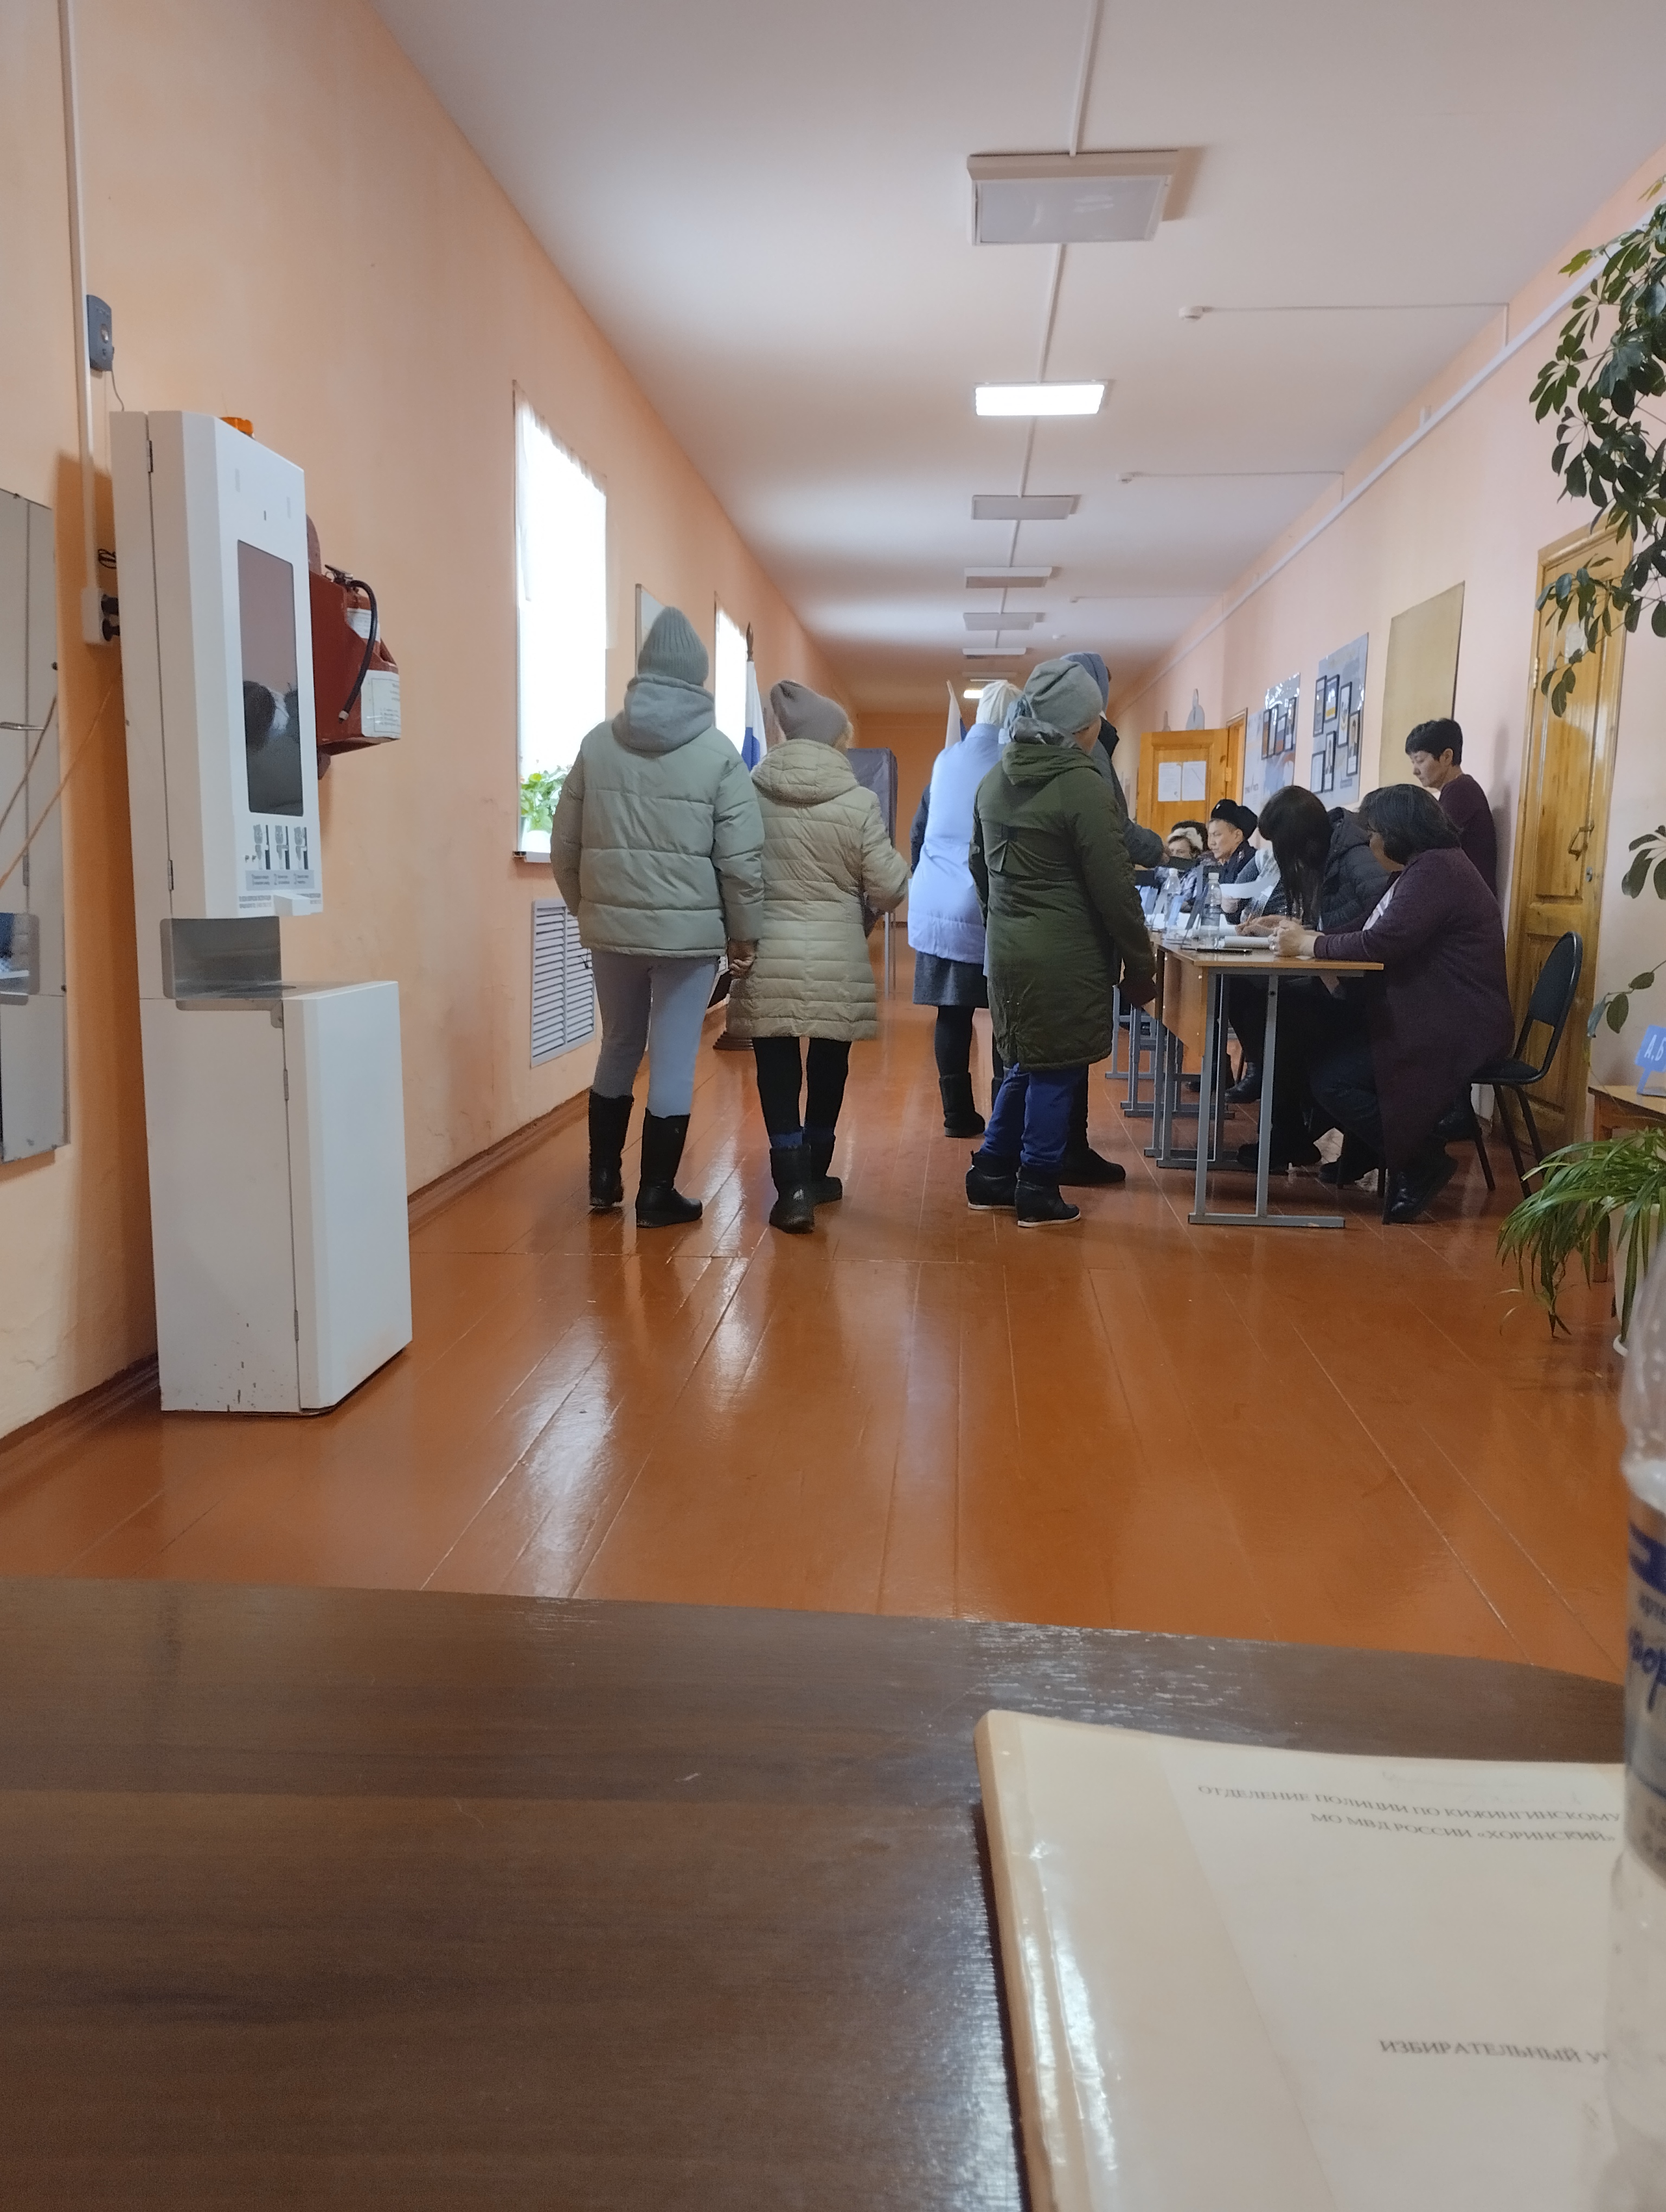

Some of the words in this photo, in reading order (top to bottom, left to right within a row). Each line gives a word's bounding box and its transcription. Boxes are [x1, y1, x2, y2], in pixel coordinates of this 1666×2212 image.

[1198, 1785, 1310, 1802] ОТДЕЛЕНИЕ
[1316, 1793, 1409, 1814] ПОЛИЦИИ
[1412, 1806, 1440, 1816] ПО
[1445, 1808, 1620, 1822] КИЖИНГИНСКОМУ
[1310, 1813, 1342, 1824] МО
[1346, 1815, 1392, 1830] МВД
[1394, 1823, 1473, 1838] РОССИИ
[1477, 1830, 1616, 1842] «ХОРИНСКИЙ»
[1380, 2039, 1580, 2063] ИЗБИРАТЕЛЬНЫЙ
